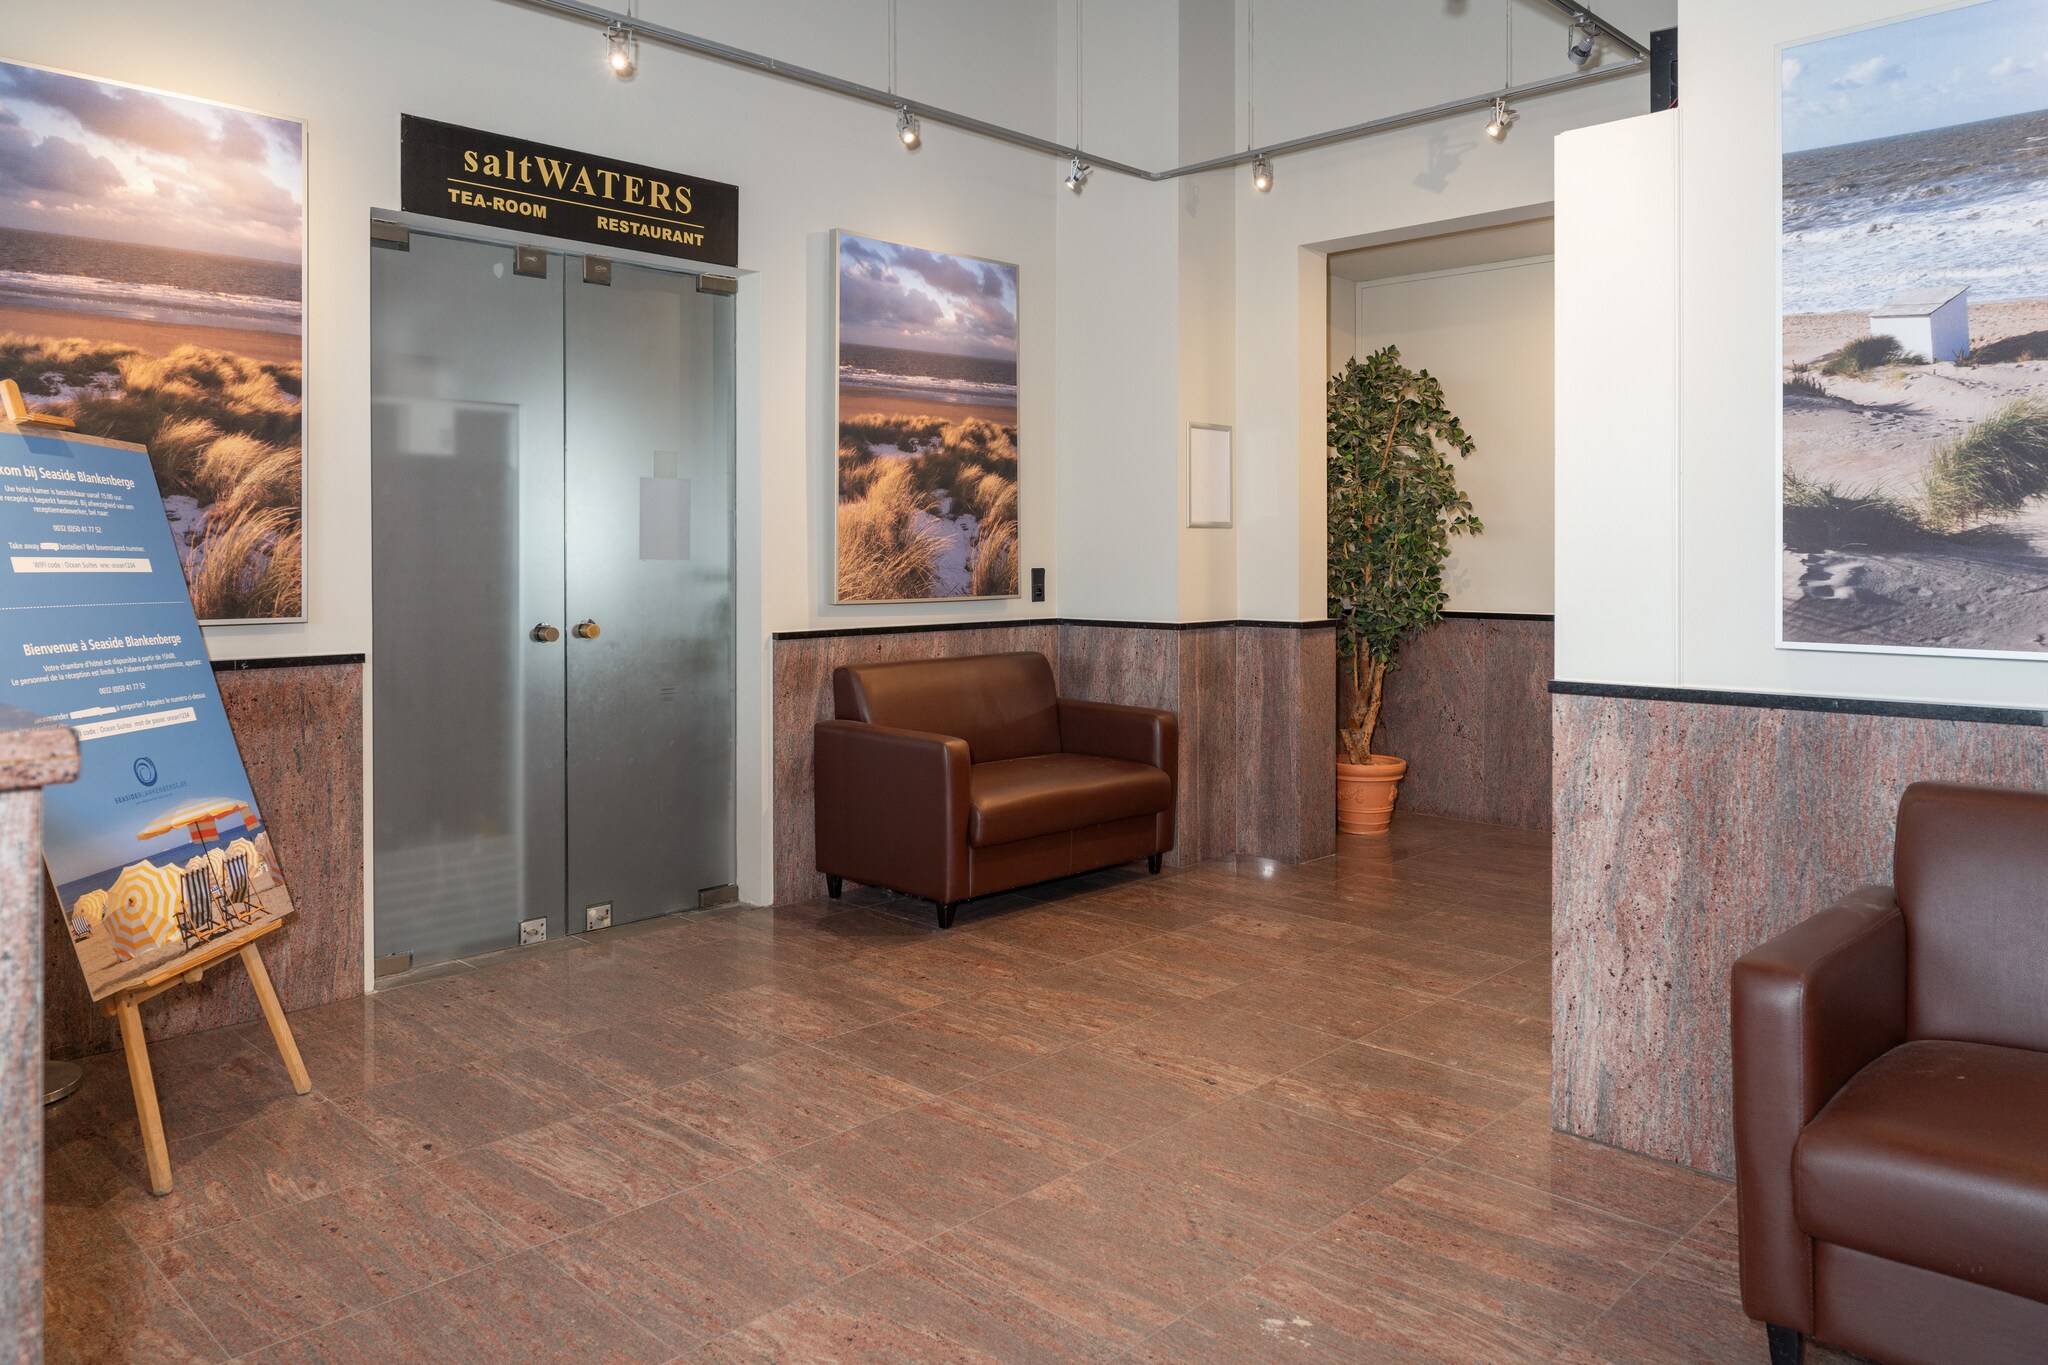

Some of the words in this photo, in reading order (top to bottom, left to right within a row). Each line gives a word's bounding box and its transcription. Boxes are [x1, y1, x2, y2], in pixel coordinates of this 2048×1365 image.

[463, 150, 693, 214] saltWATERS
[447, 188, 547, 219] TEA-ROOM
[597, 215, 704, 246] RESTAURANT
[23, 465, 38, 480] bij
[39, 467, 76, 482] Seaside
[77, 471, 135, 490] Blankenberge
[4, 495, 28, 503] receptie
[34, 496, 56, 504] beperkt
[15, 486, 31, 494] hotel
[32, 487, 49, 495] kamer
[55, 489, 85, 498] beschikbaar
[8, 542, 23, 550] Take
[59, 543, 86, 551] bestellen?
[86, 543, 95, 551] Bel
[23, 642, 79, 656] Bienvenue
[81, 639, 87, 651] à
[88, 638, 123, 650] Seaside
[125, 634, 181, 647] Blankenberge
[42, 664, 60, 672] Votre
[60, 661, 84, 671] chambre
[112, 656, 137, 665] disponible
[142, 655, 154, 663] partir
[20, 675, 50, 686] personnel
[65, 671, 91, 681] réception
[99, 687, 112, 695] 0032
[139, 682, 146, 690] 52
[120, 700, 146, 710] emporter?
[146, 698, 165, 707] Appelez
[100, 724, 117, 733] Ocean
[117, 722, 132, 730] Suites
[167, 711, 190, 721] ocean1234
